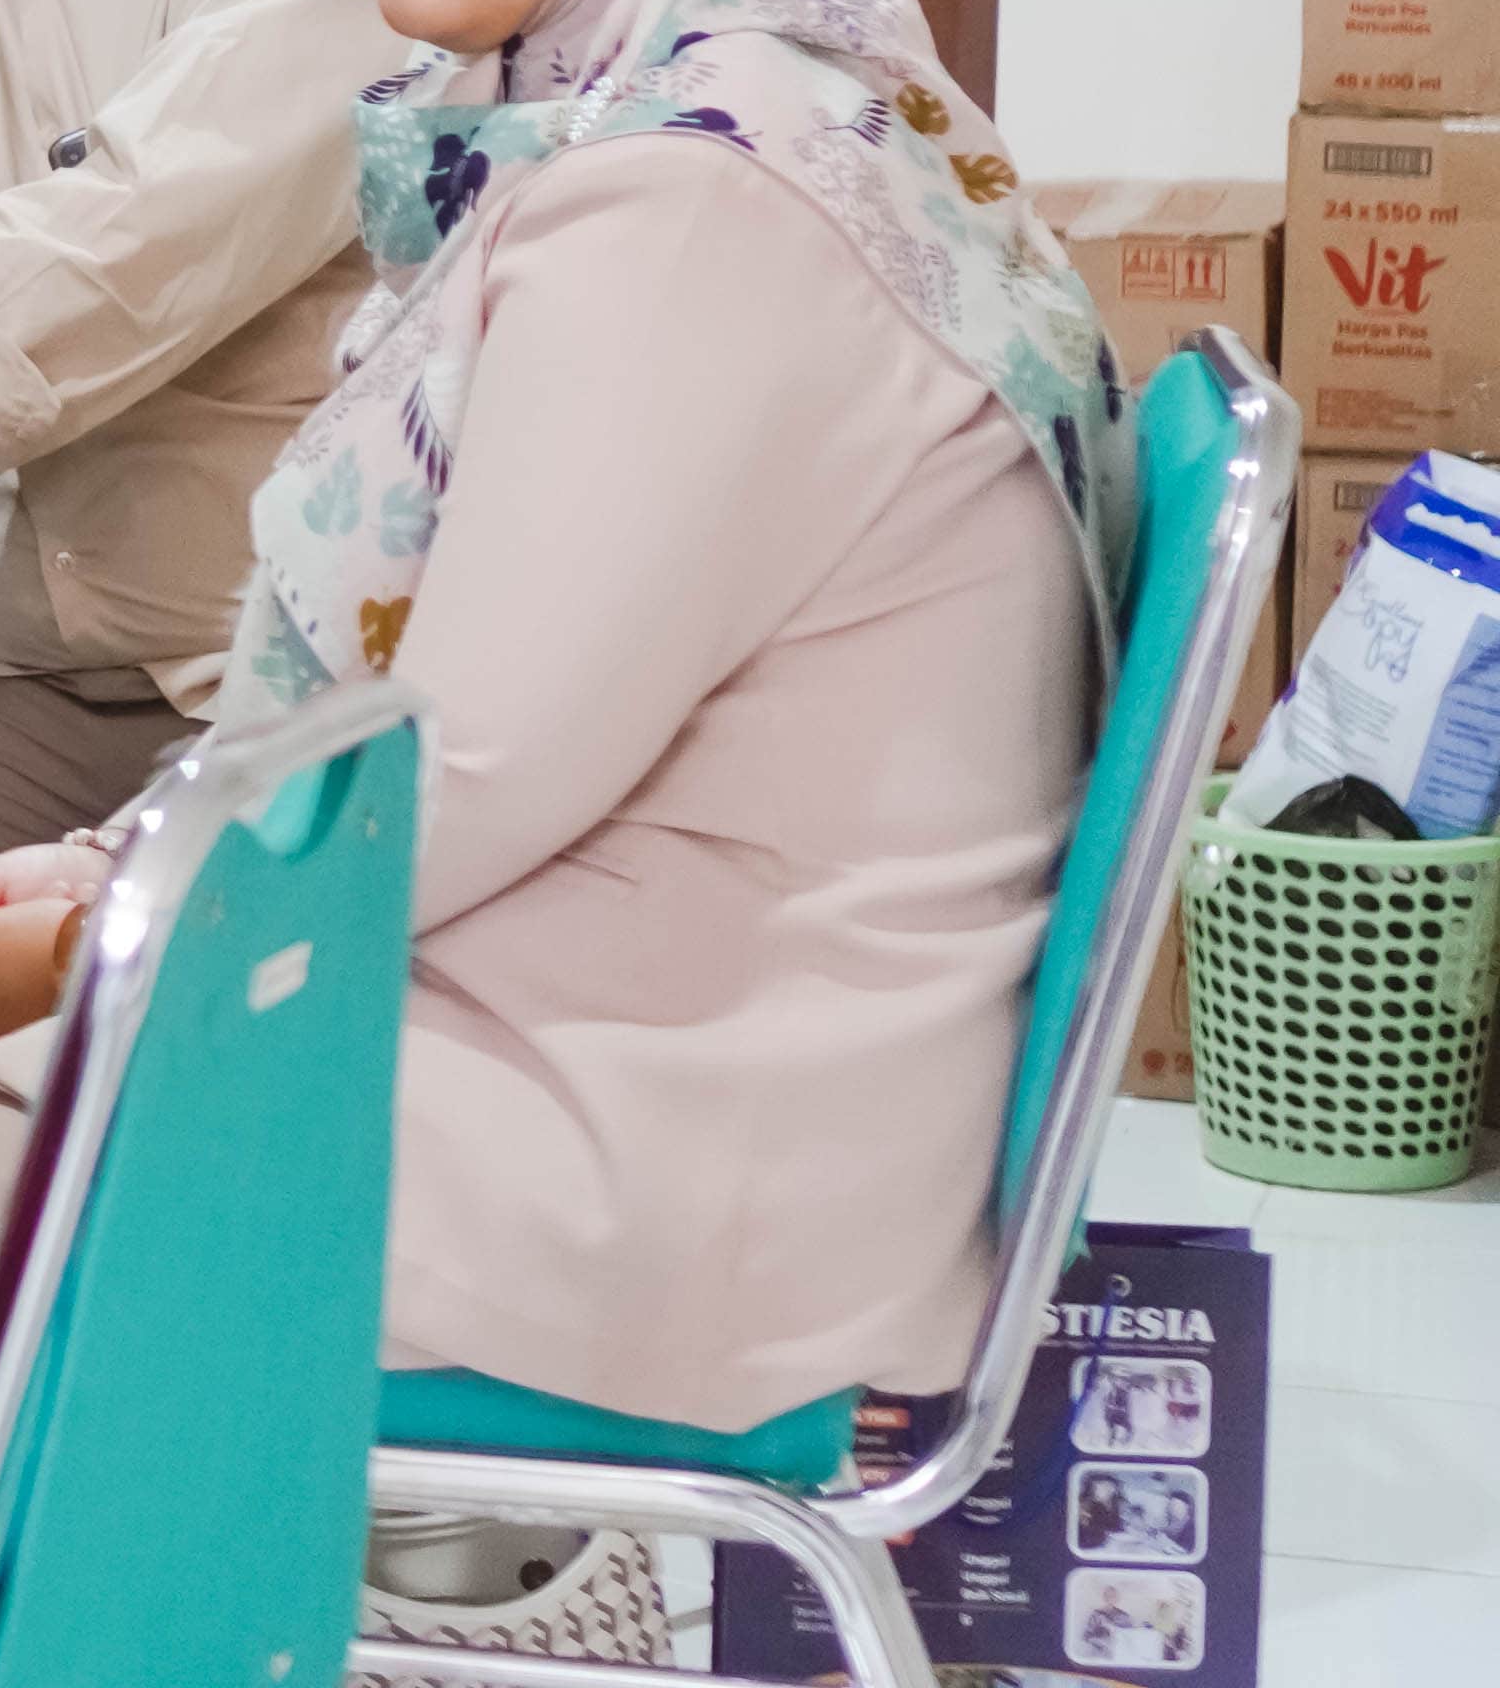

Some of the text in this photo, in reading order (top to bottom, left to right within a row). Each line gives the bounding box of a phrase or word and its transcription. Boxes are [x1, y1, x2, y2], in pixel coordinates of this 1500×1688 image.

[1323, 200, 1351, 220] 24
[1376, 202, 1421, 223] 550
[1429, 206, 1458, 224] ml
[1322, 236, 1447, 313] Vit
[1040, 1302, 1216, 1343] STIESIA
